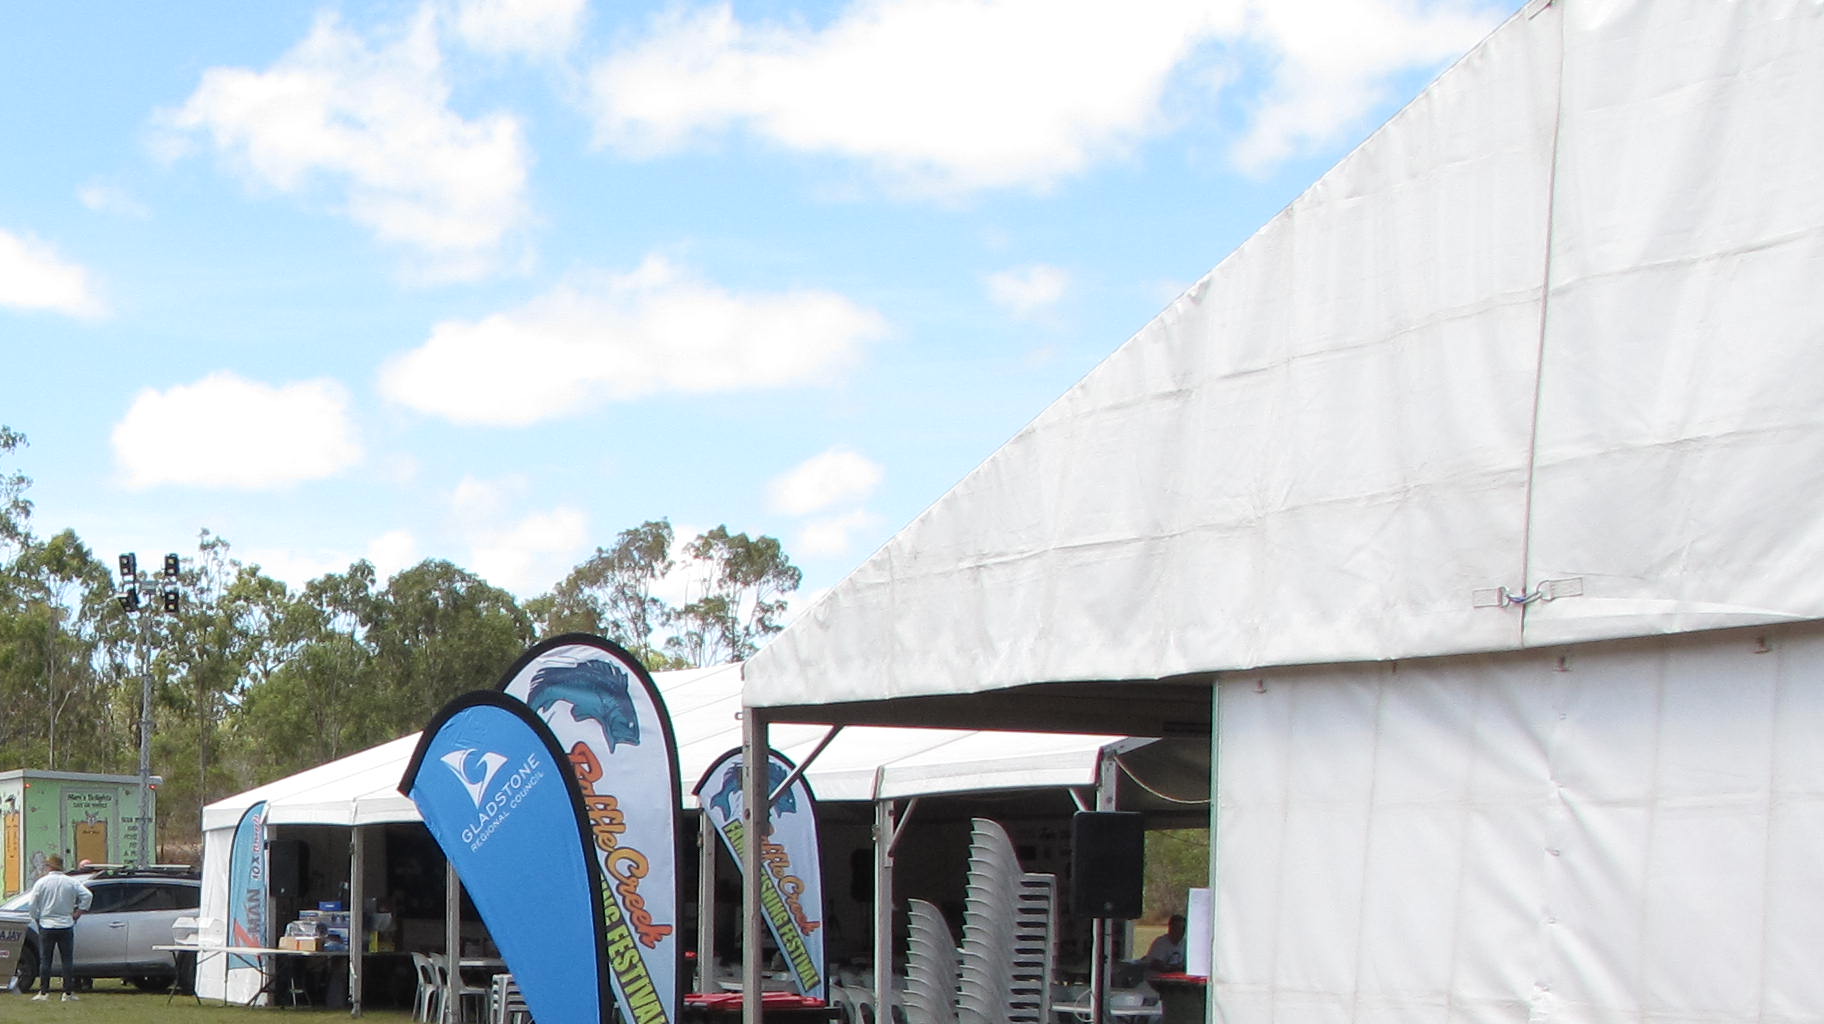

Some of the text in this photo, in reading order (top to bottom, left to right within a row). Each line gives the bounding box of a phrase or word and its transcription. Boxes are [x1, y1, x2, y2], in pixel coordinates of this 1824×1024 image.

[461, 753, 540, 843] GLADSTONE
[470, 771, 545, 853] REGIONAL COUNCIL
[605, 847, 673, 949] Creek
[778, 922, 821, 990] FESTIVAL
